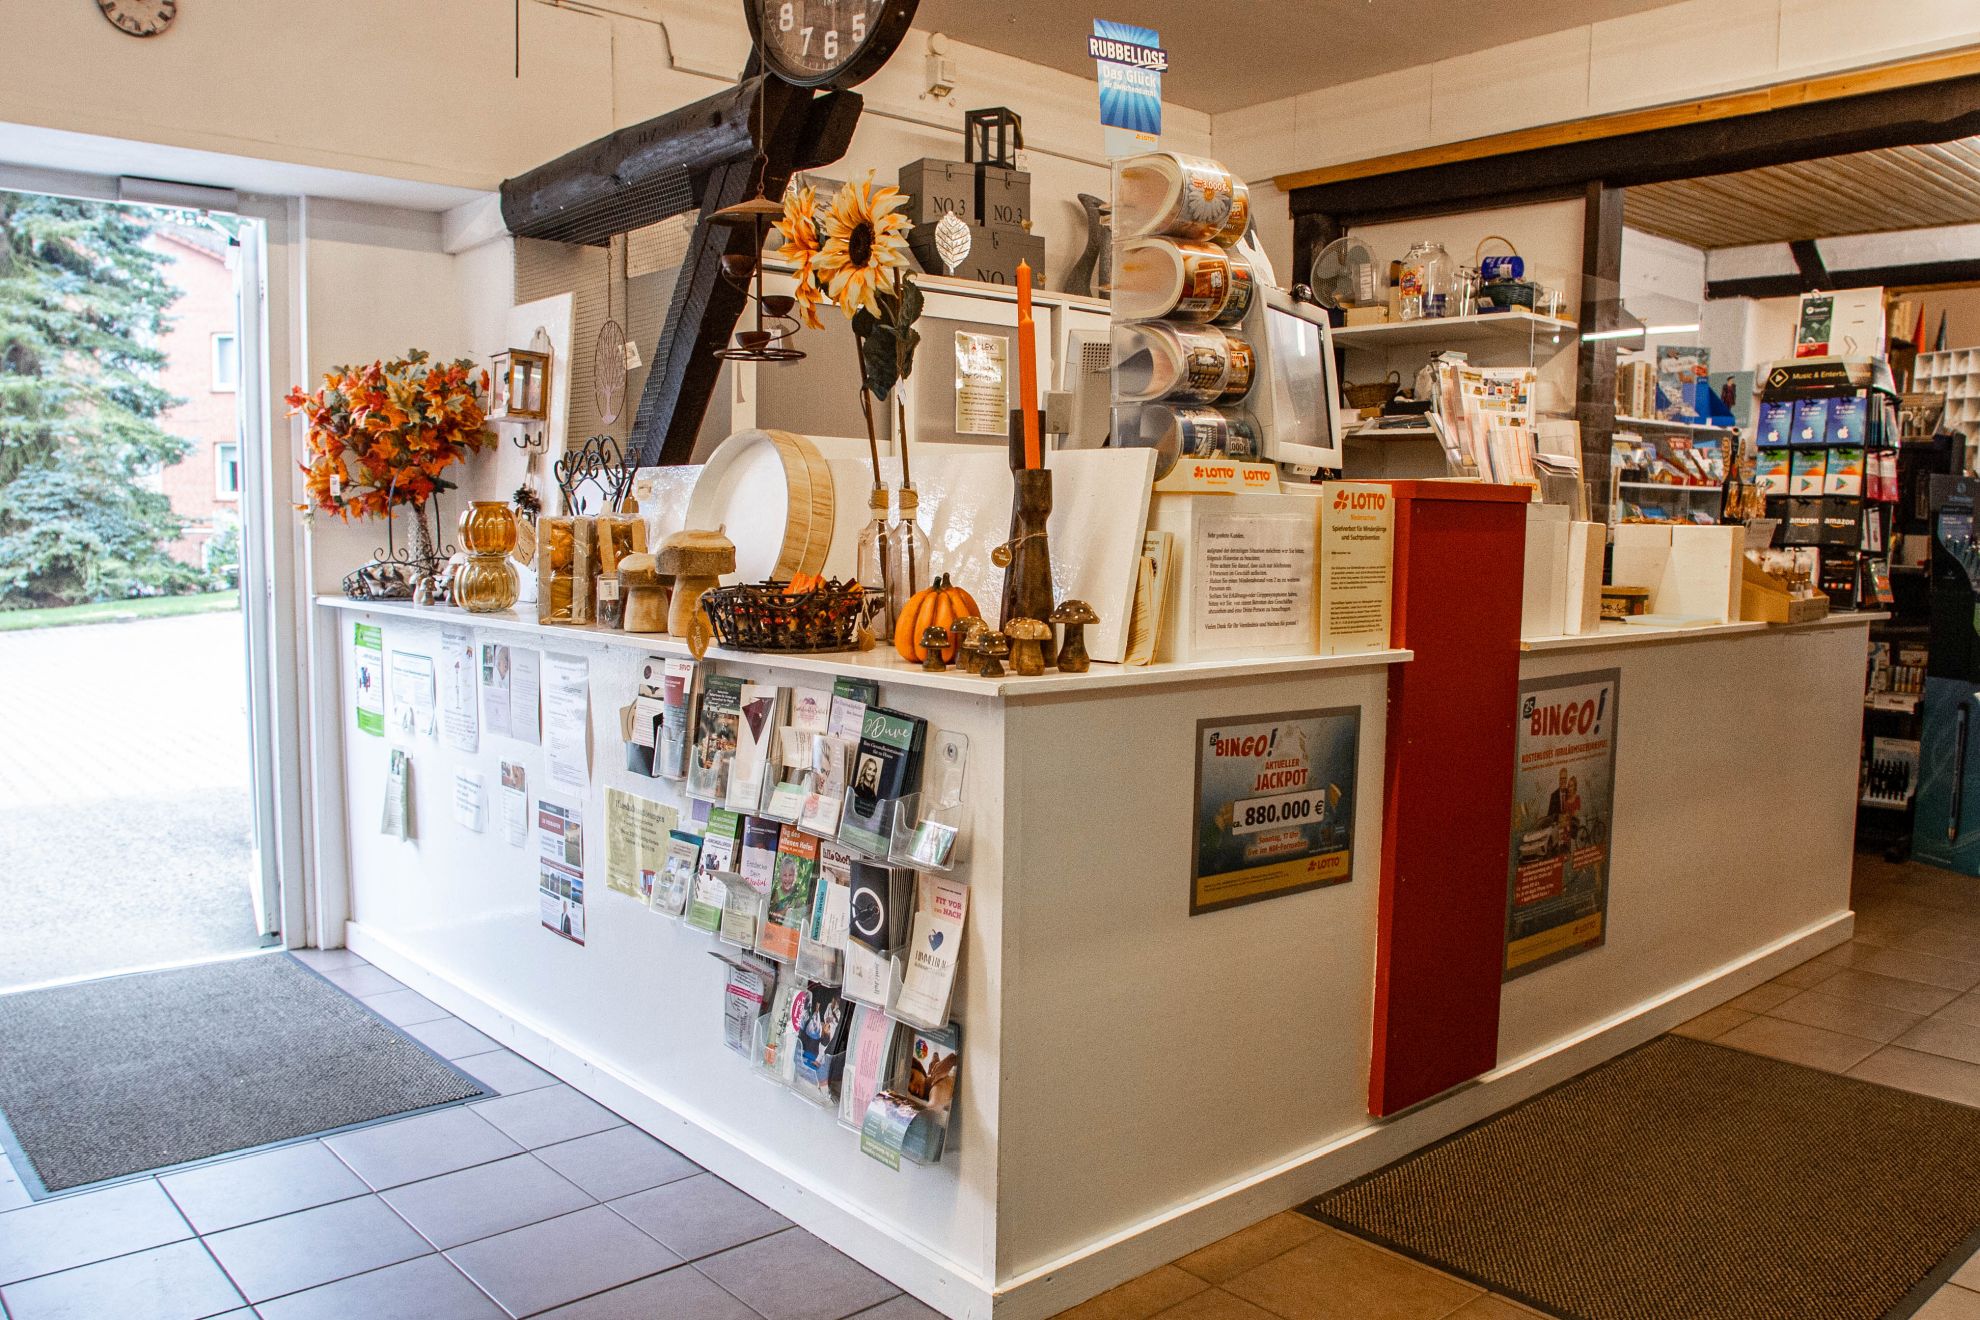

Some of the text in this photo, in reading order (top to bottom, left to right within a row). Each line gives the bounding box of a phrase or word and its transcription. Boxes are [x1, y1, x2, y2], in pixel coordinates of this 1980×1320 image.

[780, 2, 794, 32] 8
[852, 13, 866, 43] 5
[800, 26, 814, 57] 7
[824, 30, 839, 60] 6
[1089, 38, 1165, 66] RUBBELLOSE
[1102, 65, 1156, 88] Das Glück
[933, 196, 966, 216] NO.3
[993, 204, 1023, 225] NO.3
[1792, 371, 1812, 380] Music
[1813, 371, 1819, 379] &
[1205, 466, 1235, 479] LOTTO
[1242, 469, 1271, 482] LOTTO
[1351, 492, 1386, 511] LOTTO
[1789, 518, 1819, 526] amazon
[1824, 518, 1856, 526] amazon
[1531, 688, 1608, 736] BINGO!
[1215, 728, 1278, 758] BINGO!
[1265, 758, 1300, 770] AKTUELLER
[1255, 768, 1309, 792] JACKPOT
[1244, 799, 1310, 826] 880.000
[1315, 800, 1324, 815] €
[1317, 856, 1340, 870] LOTTO
[935, 896, 962, 911] FIT VOR
[942, 907, 962, 919] NACH
